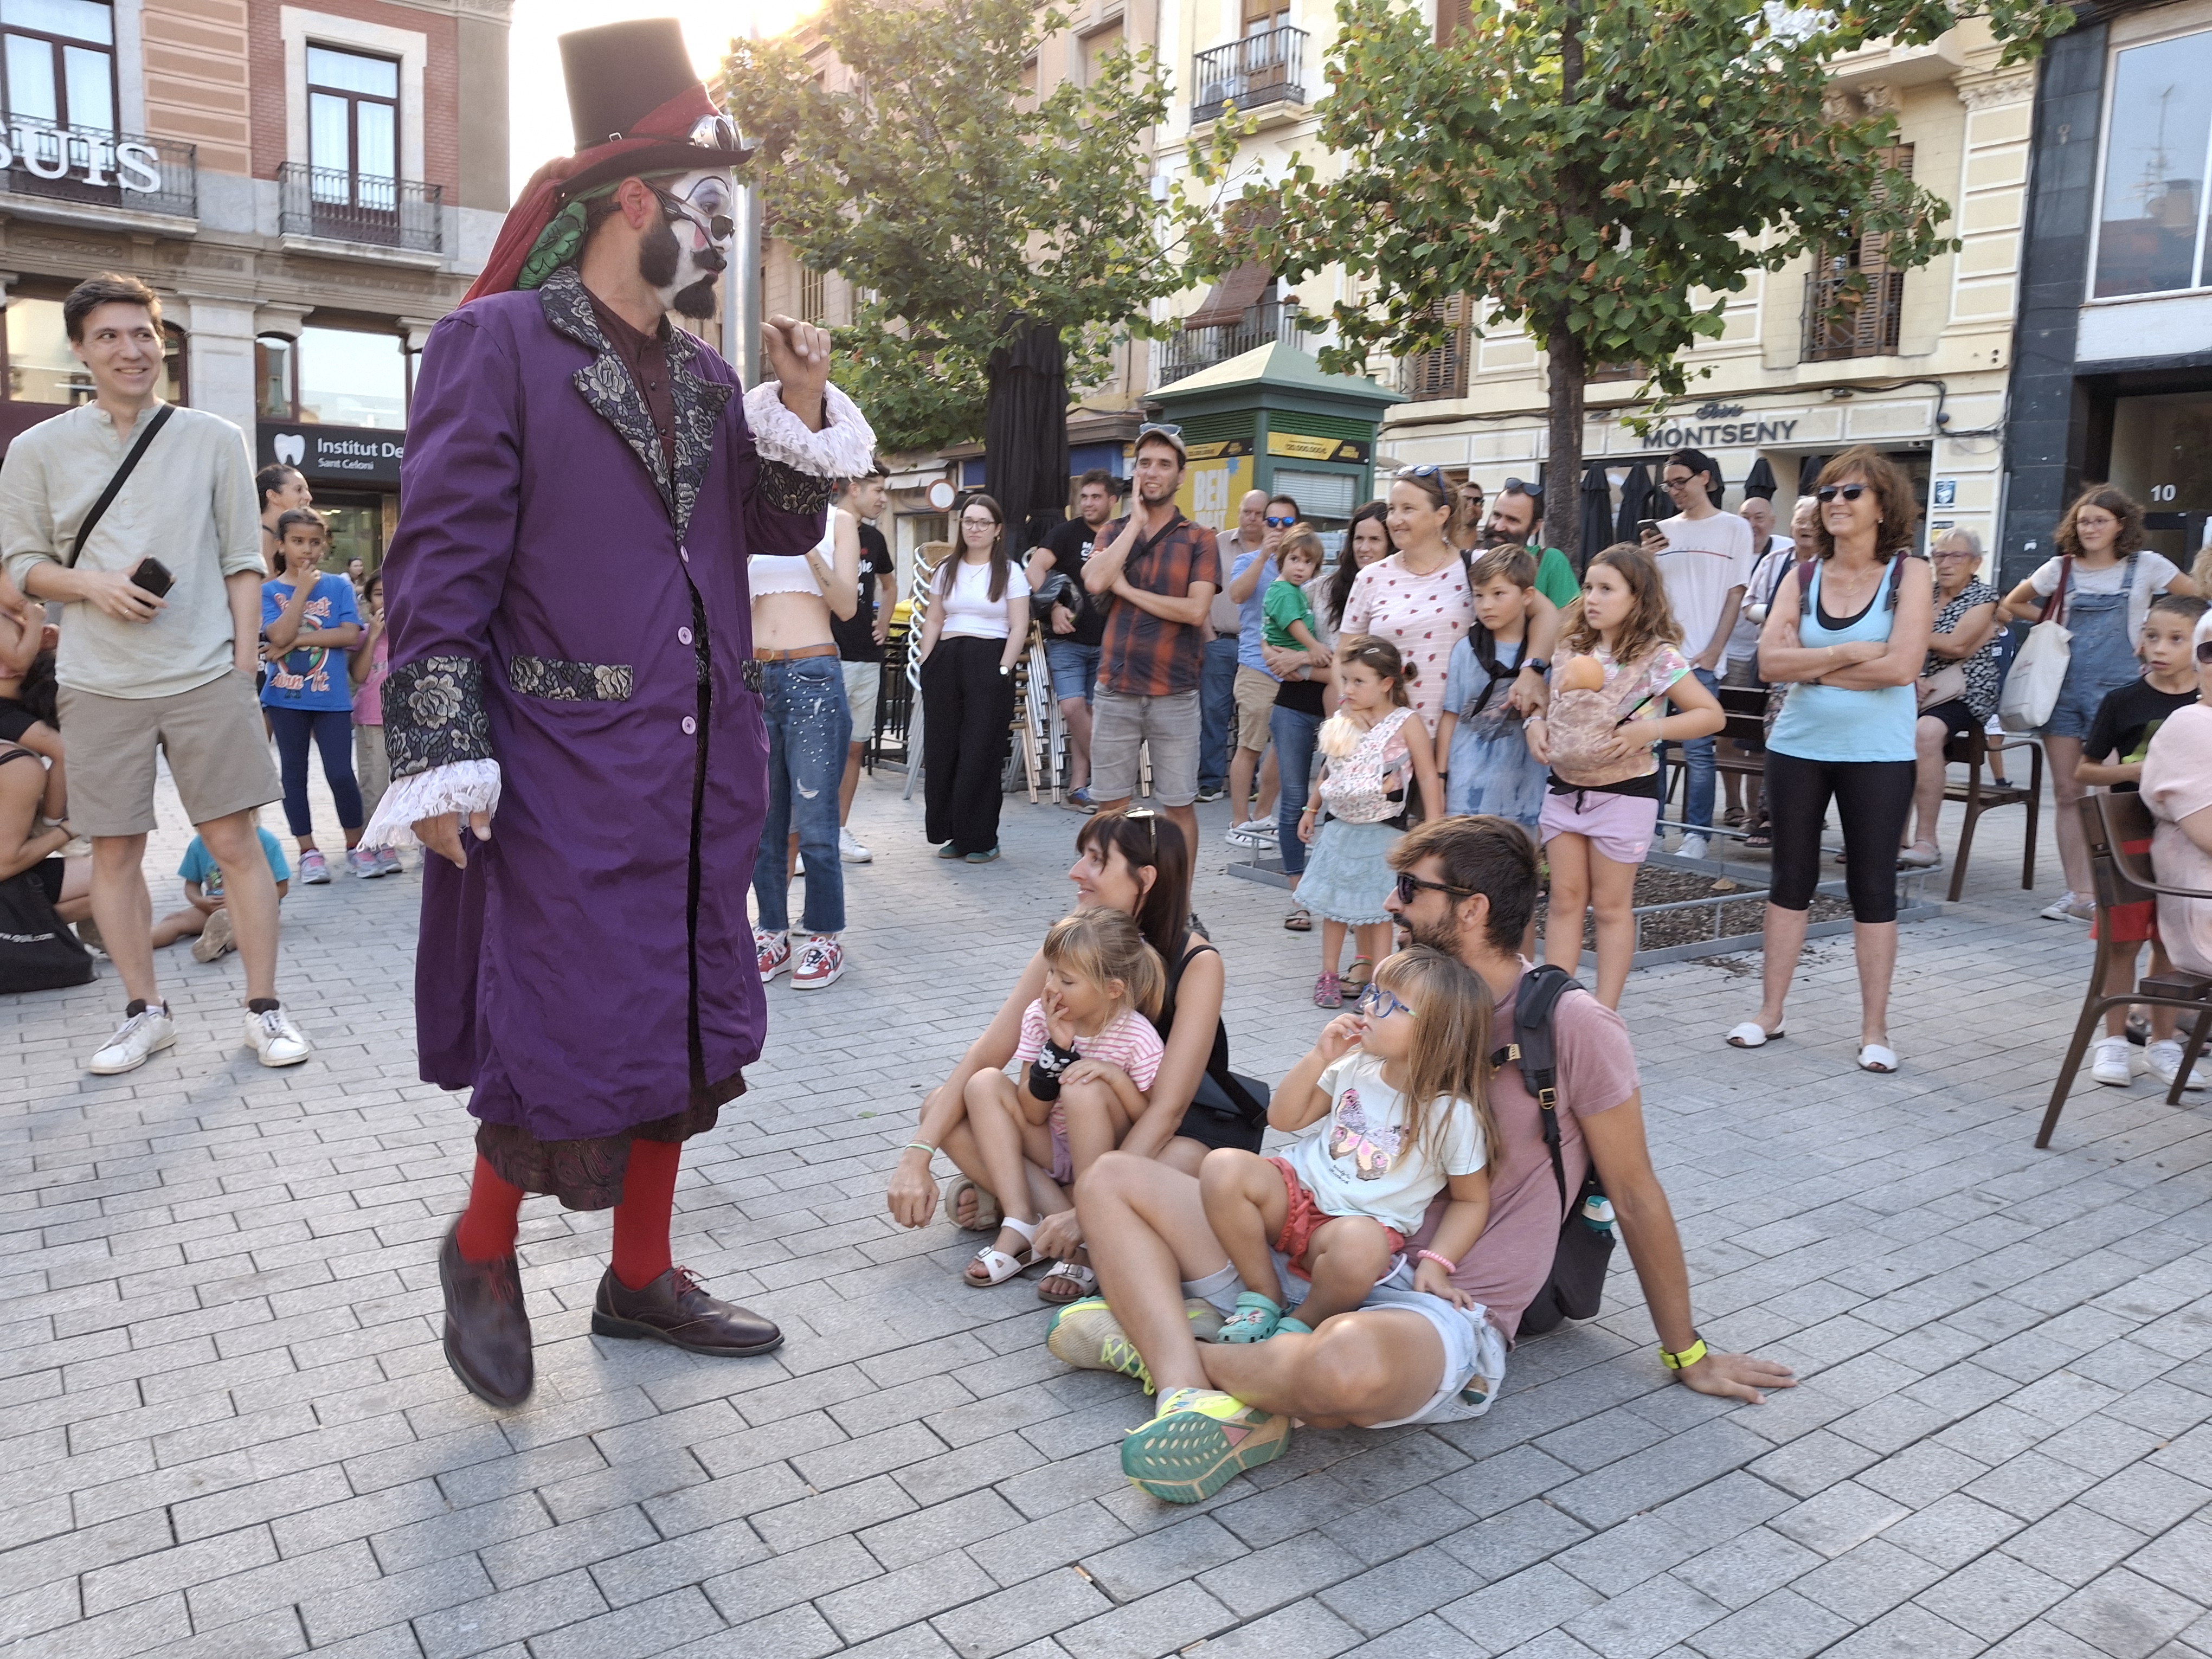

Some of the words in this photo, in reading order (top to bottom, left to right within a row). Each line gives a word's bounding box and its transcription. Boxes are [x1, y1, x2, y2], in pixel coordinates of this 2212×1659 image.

[1643, 420, 1798, 449] MONTSENY
[318, 438, 378, 457] Institut
[318, 458, 341, 468] Sant
[342, 459, 374, 470] Celoni
[2150, 484, 2176, 501] 10
